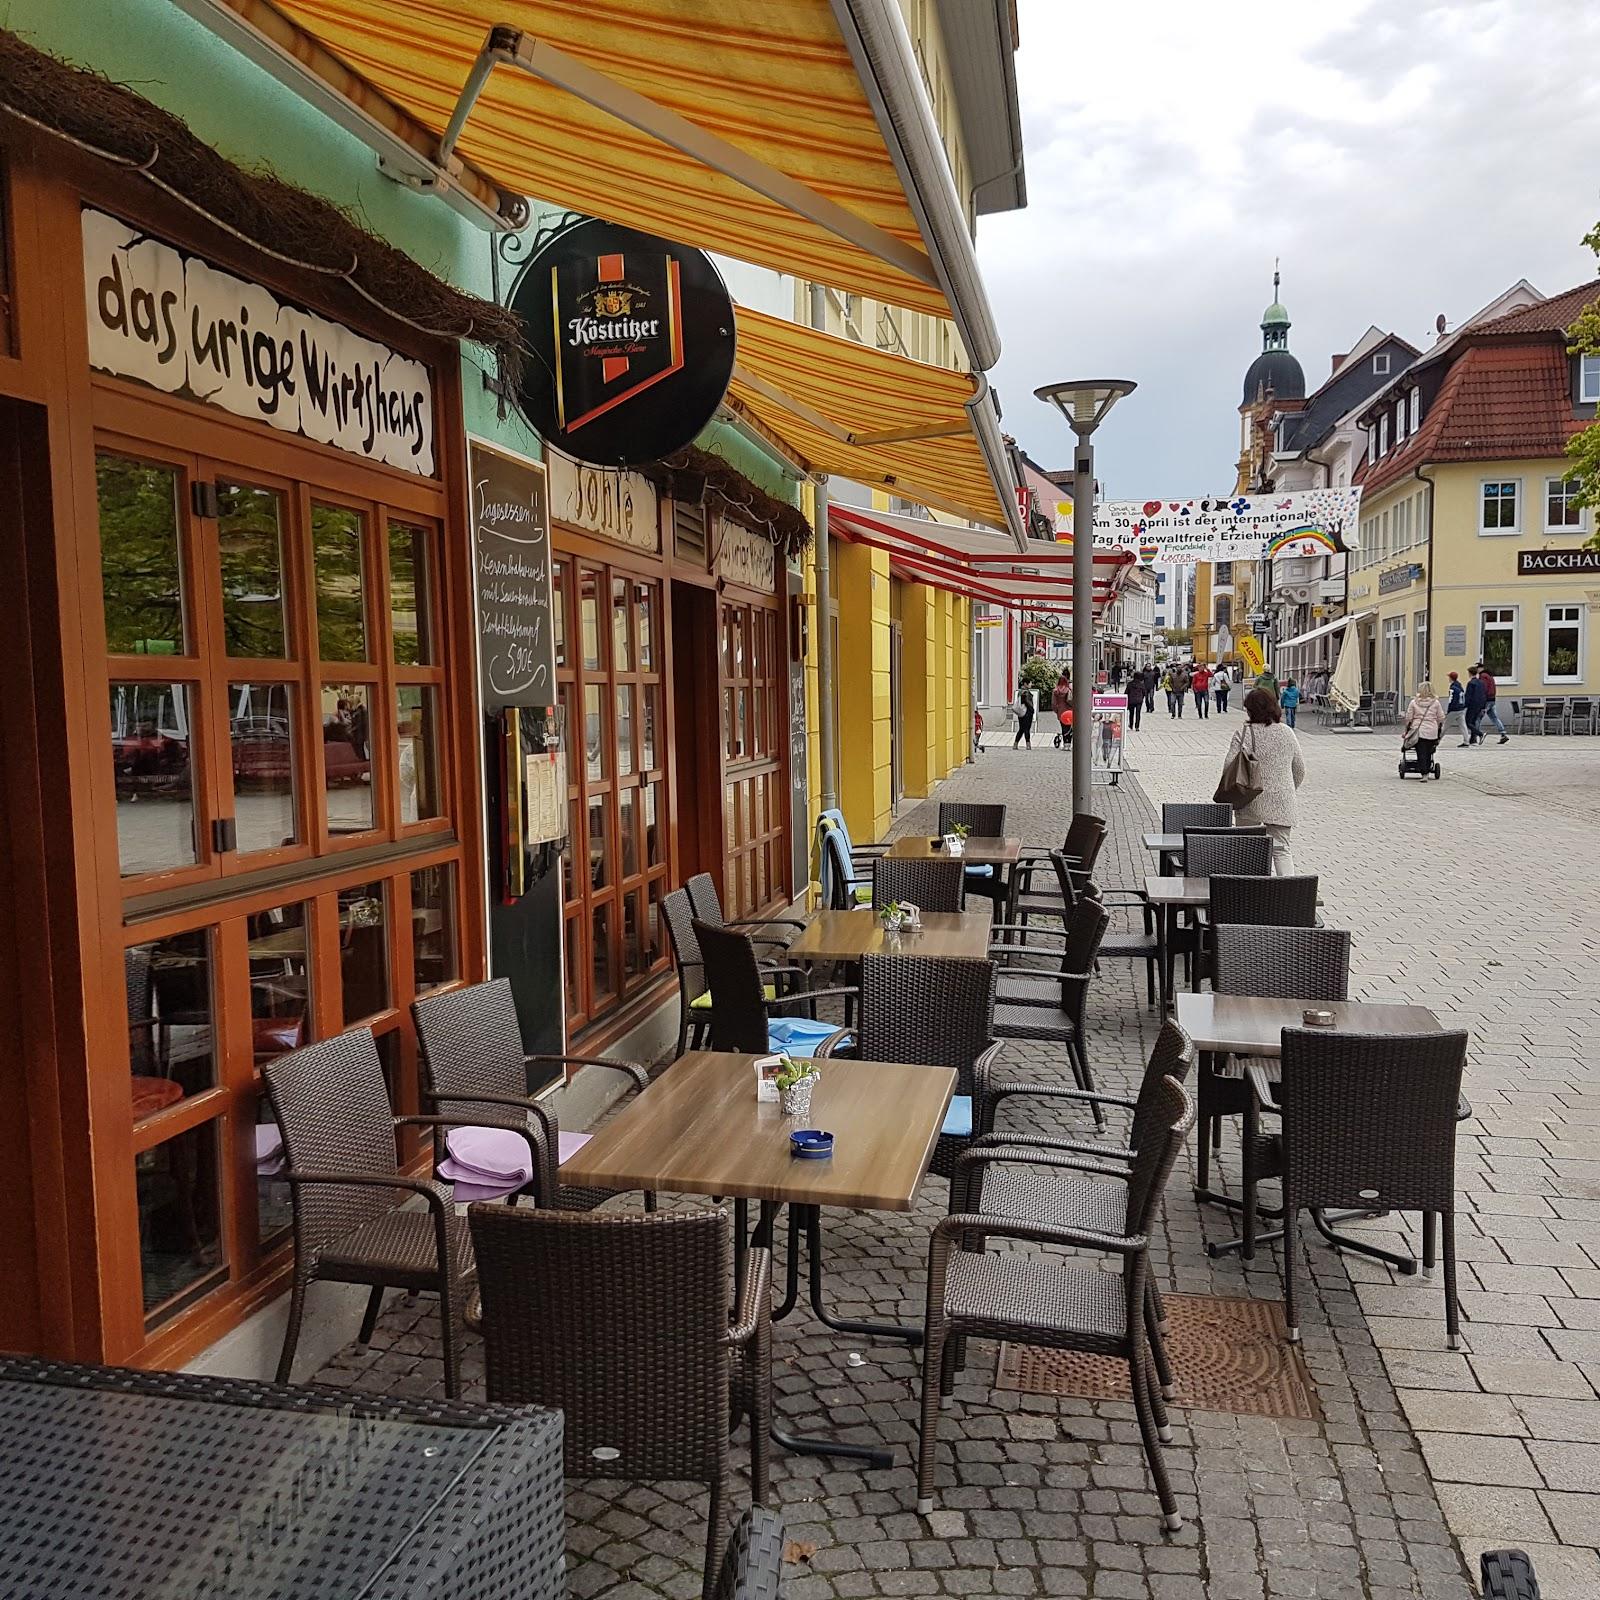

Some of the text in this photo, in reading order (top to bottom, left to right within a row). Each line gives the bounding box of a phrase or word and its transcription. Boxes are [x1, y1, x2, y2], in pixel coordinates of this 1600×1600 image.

[568, 317, 660, 346] Köstritzer
[98, 253, 424, 455] das urige Wirtshaus
[1115, 518, 1134, 528] 30.
[1139, 517, 1169, 530] April
[1173, 517, 1191, 527] ist
[1194, 515, 1217, 526] der
[1221, 510, 1318, 525] internationale
[1092, 534, 1113, 545] Tag
[1117, 534, 1136, 544] für
[1139, 533, 1215, 545] gewaltfreie
[1246, 647, 1259, 666] LOTTO
